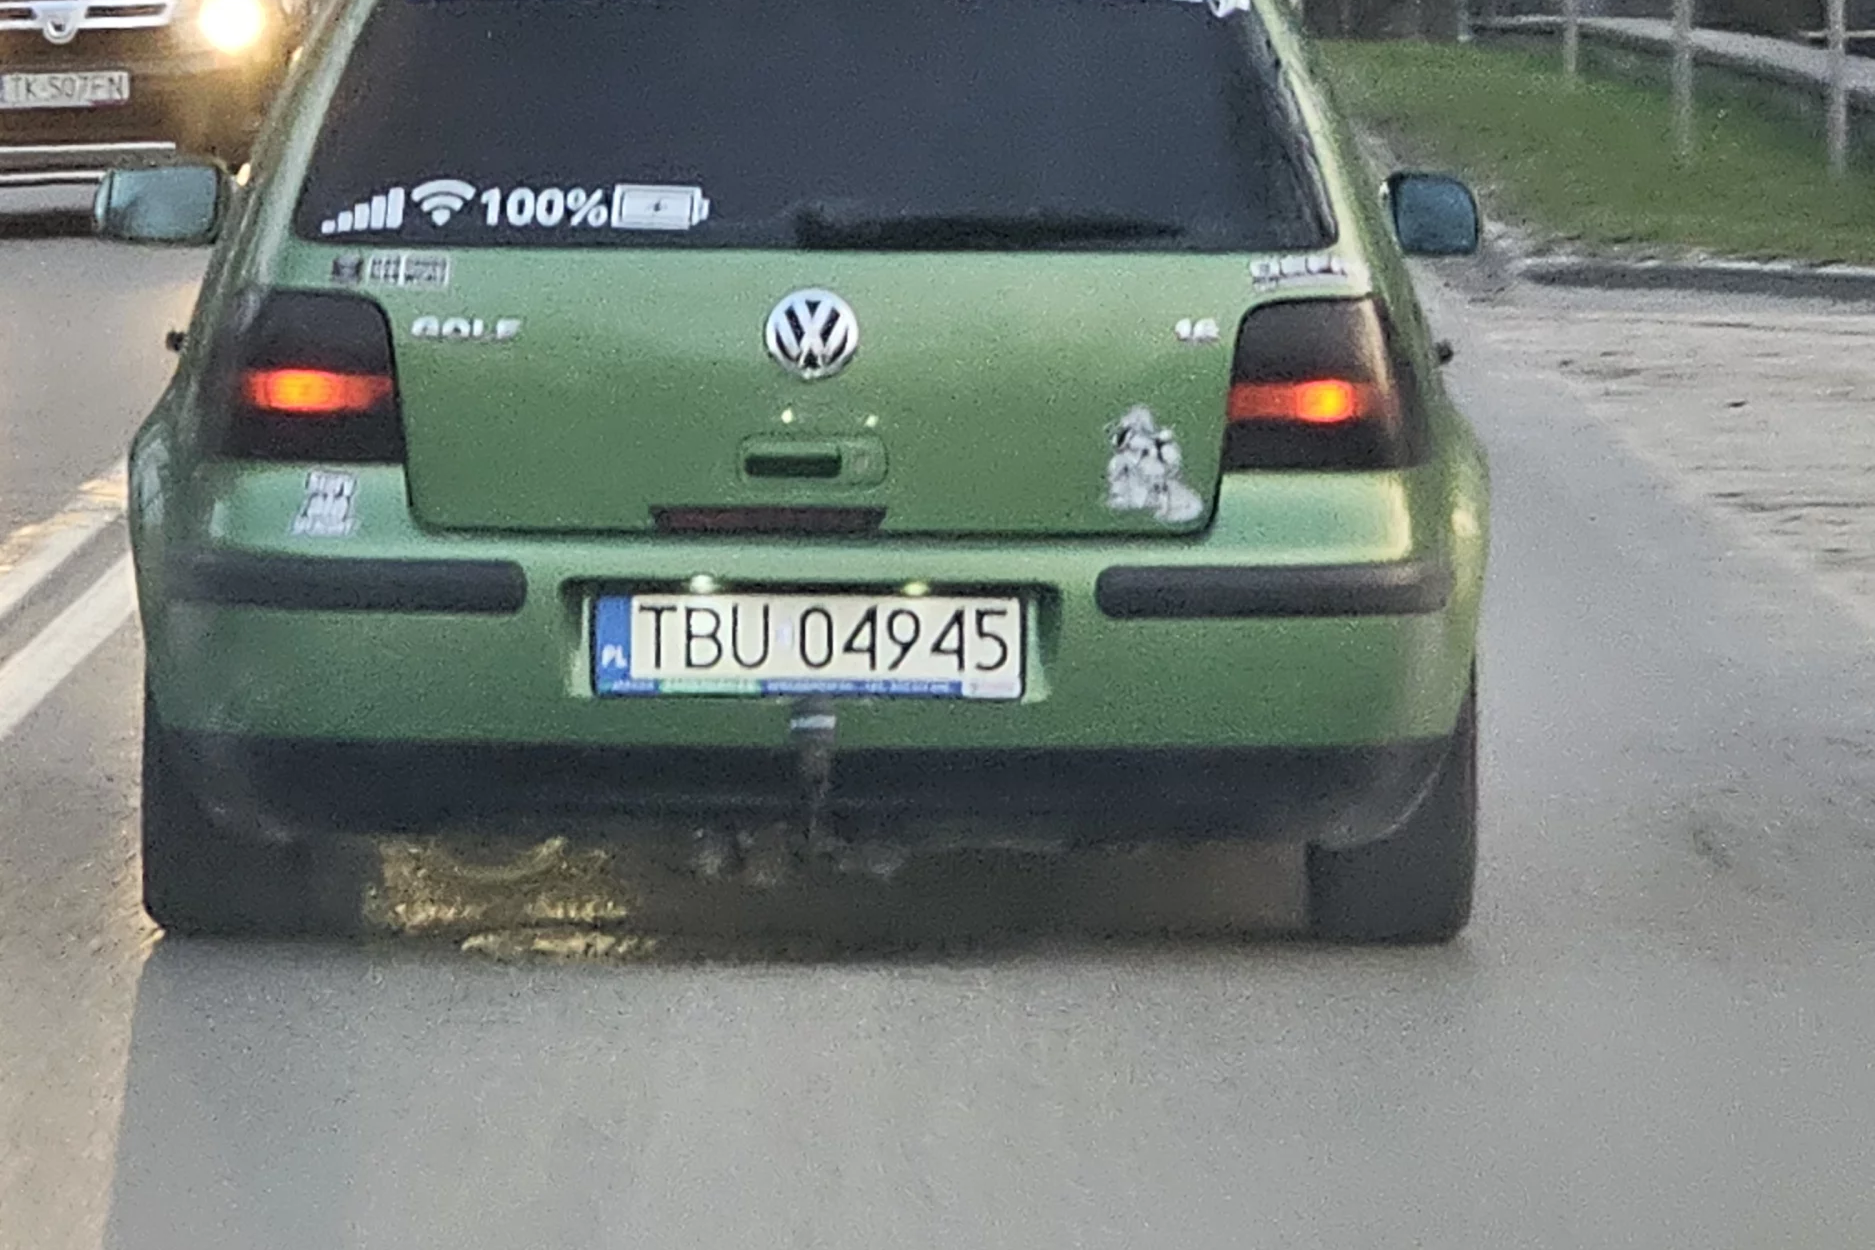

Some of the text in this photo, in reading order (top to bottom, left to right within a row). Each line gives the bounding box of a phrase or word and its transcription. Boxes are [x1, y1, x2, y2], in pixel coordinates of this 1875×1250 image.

[481, 186, 608, 227] 100%
[602, 643, 627, 668] PL
[638, 603, 1008, 671] TBU 04945
